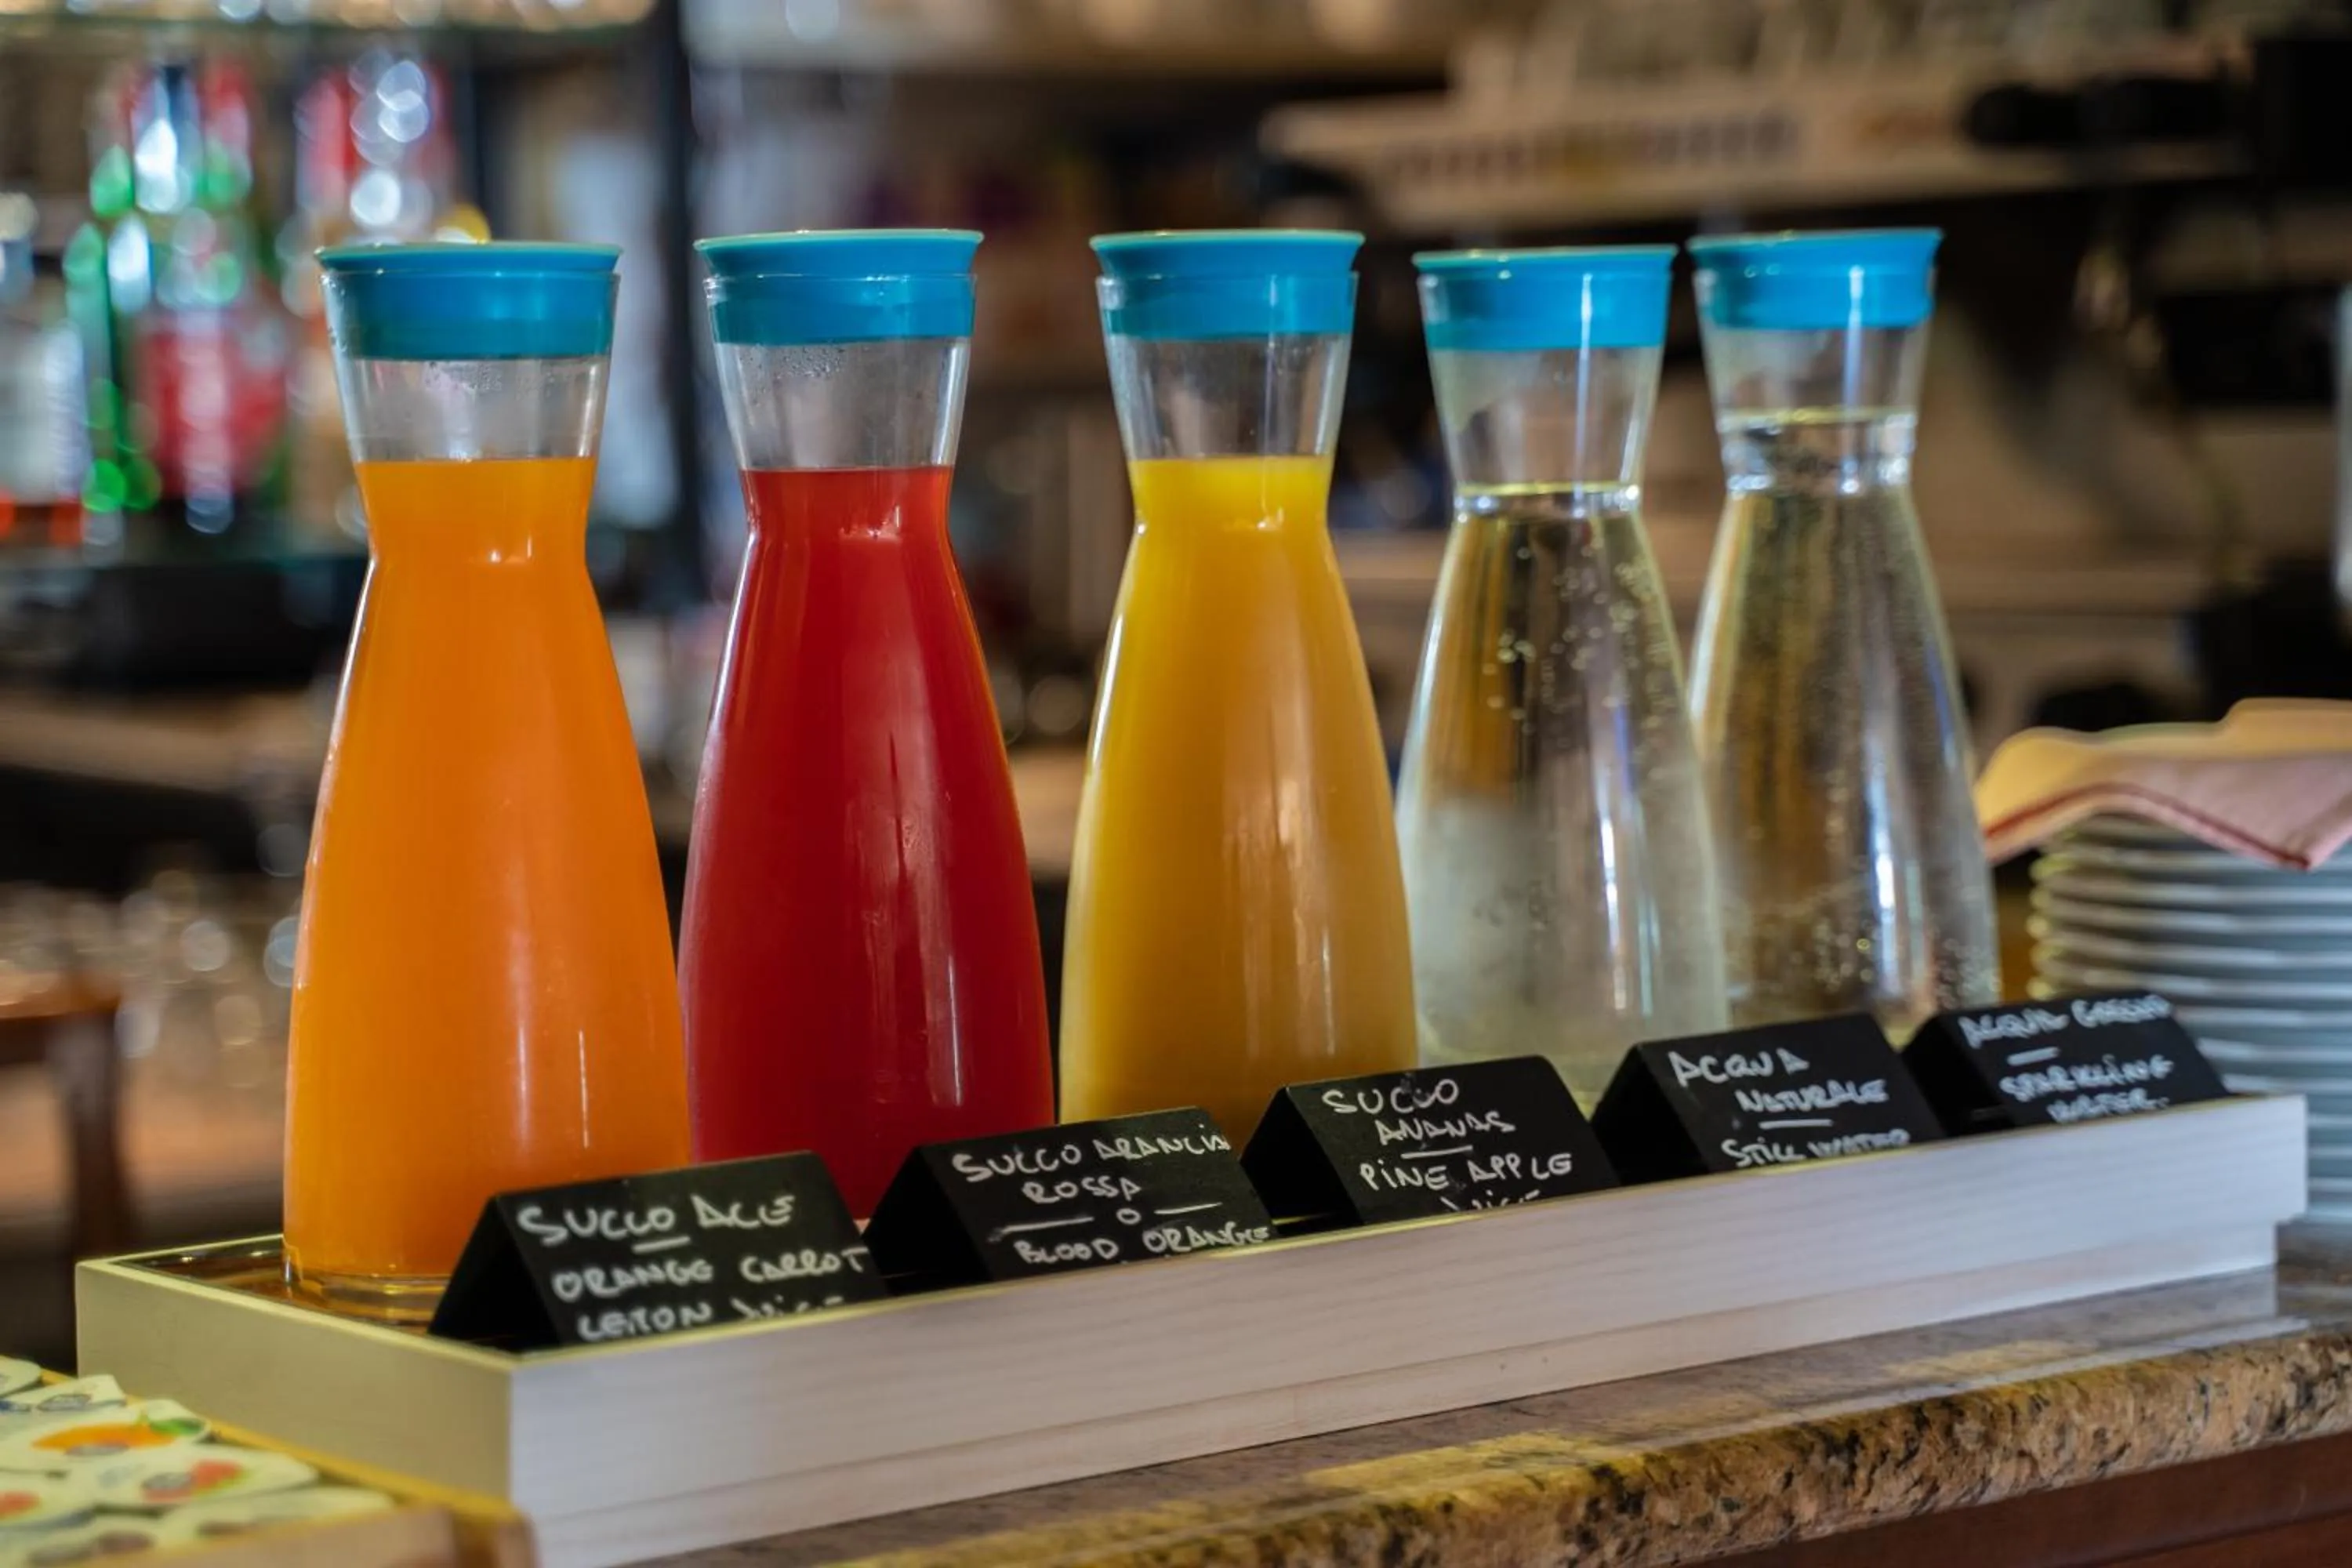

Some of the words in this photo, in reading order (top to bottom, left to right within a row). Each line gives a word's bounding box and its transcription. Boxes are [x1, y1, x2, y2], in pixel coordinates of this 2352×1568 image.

[1667, 1047, 1810, 1087] ACQUA
[1322, 1078, 1459, 1114] SUCCO
[1734, 1078, 1889, 1113] NATURALE
[1374, 1111, 1516, 1146] ANANAS
[952, 1144, 1082, 1182] SUCCO
[1467, 1152, 1573, 1183] APPLE
[1721, 1136, 1807, 1168] STILL
[1022, 1176, 1142, 1203] ROSSA
[517, 1203, 677, 1247] SUCCO
[691, 1193, 796, 1229] ACE
[1014, 1237, 1120, 1264] BLOOD
[1142, 1221, 1270, 1253] ORANGE
[552, 1258, 714, 1301] ORANGE
[740, 1247, 869, 1283] CARROT
